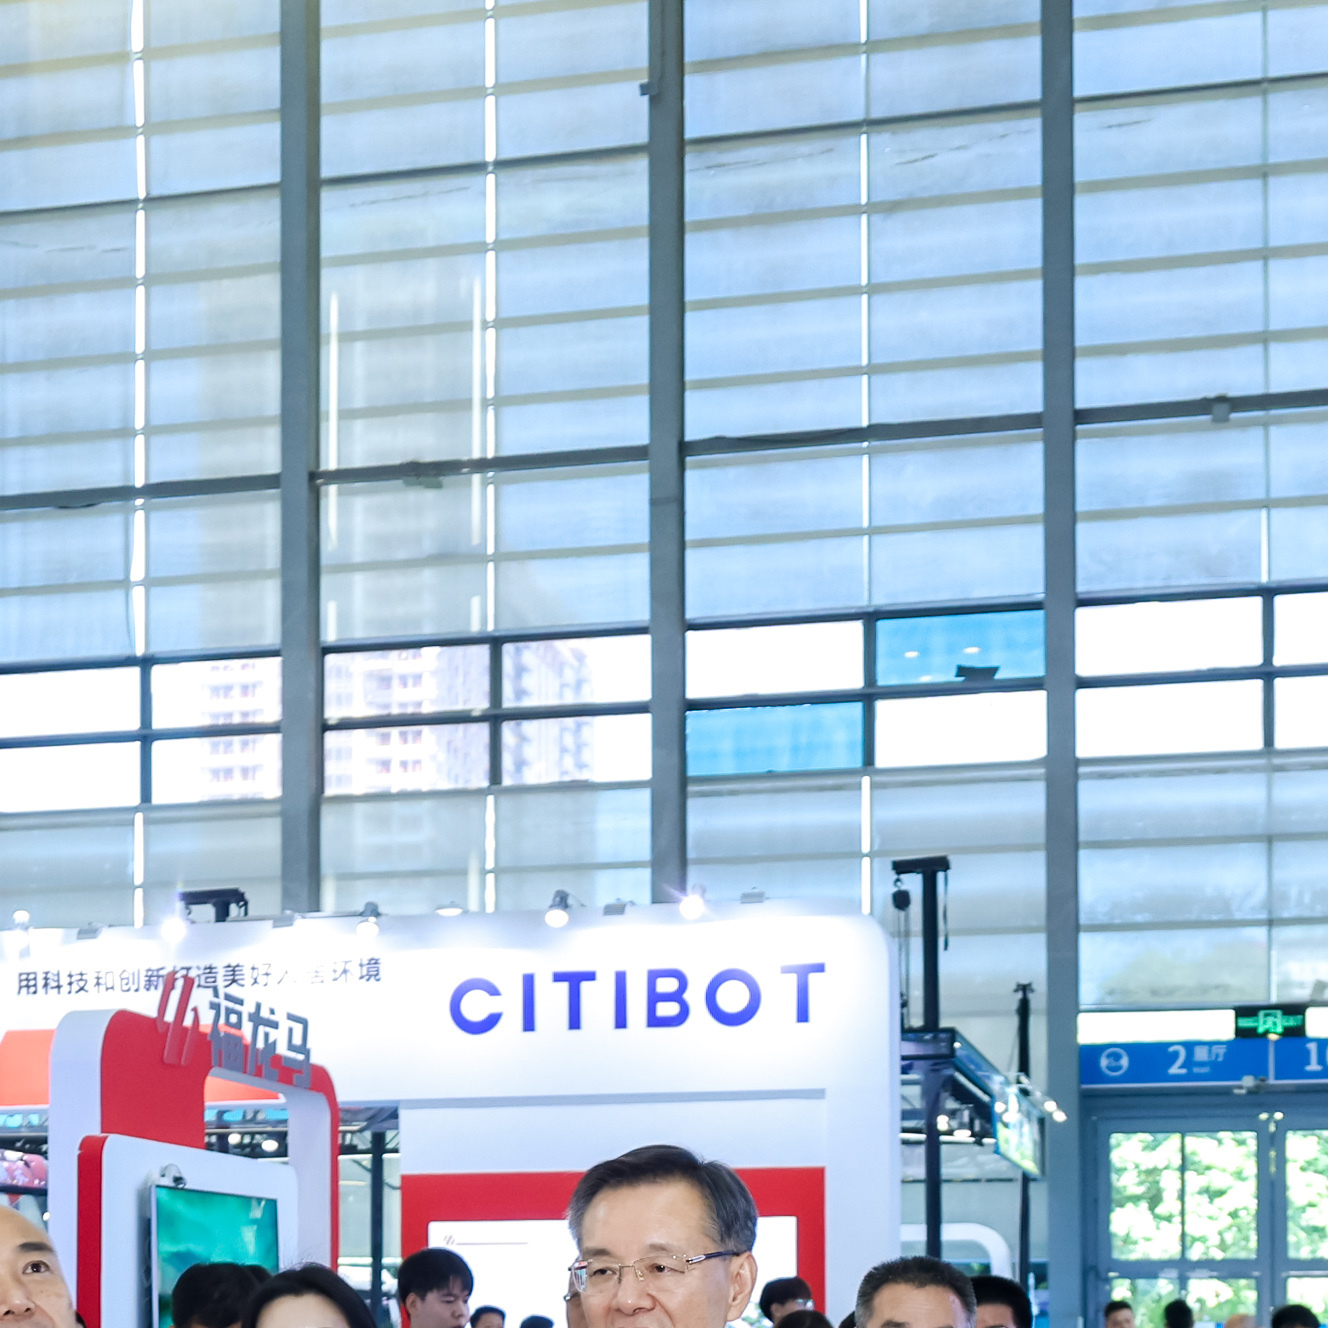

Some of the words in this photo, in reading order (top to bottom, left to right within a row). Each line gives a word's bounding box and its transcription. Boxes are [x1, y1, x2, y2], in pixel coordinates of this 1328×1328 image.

[450, 962, 825, 1035] CITIBOT
[209, 986, 312, 1089] 福龙马
[1167, 1045, 1188, 1075] 2
